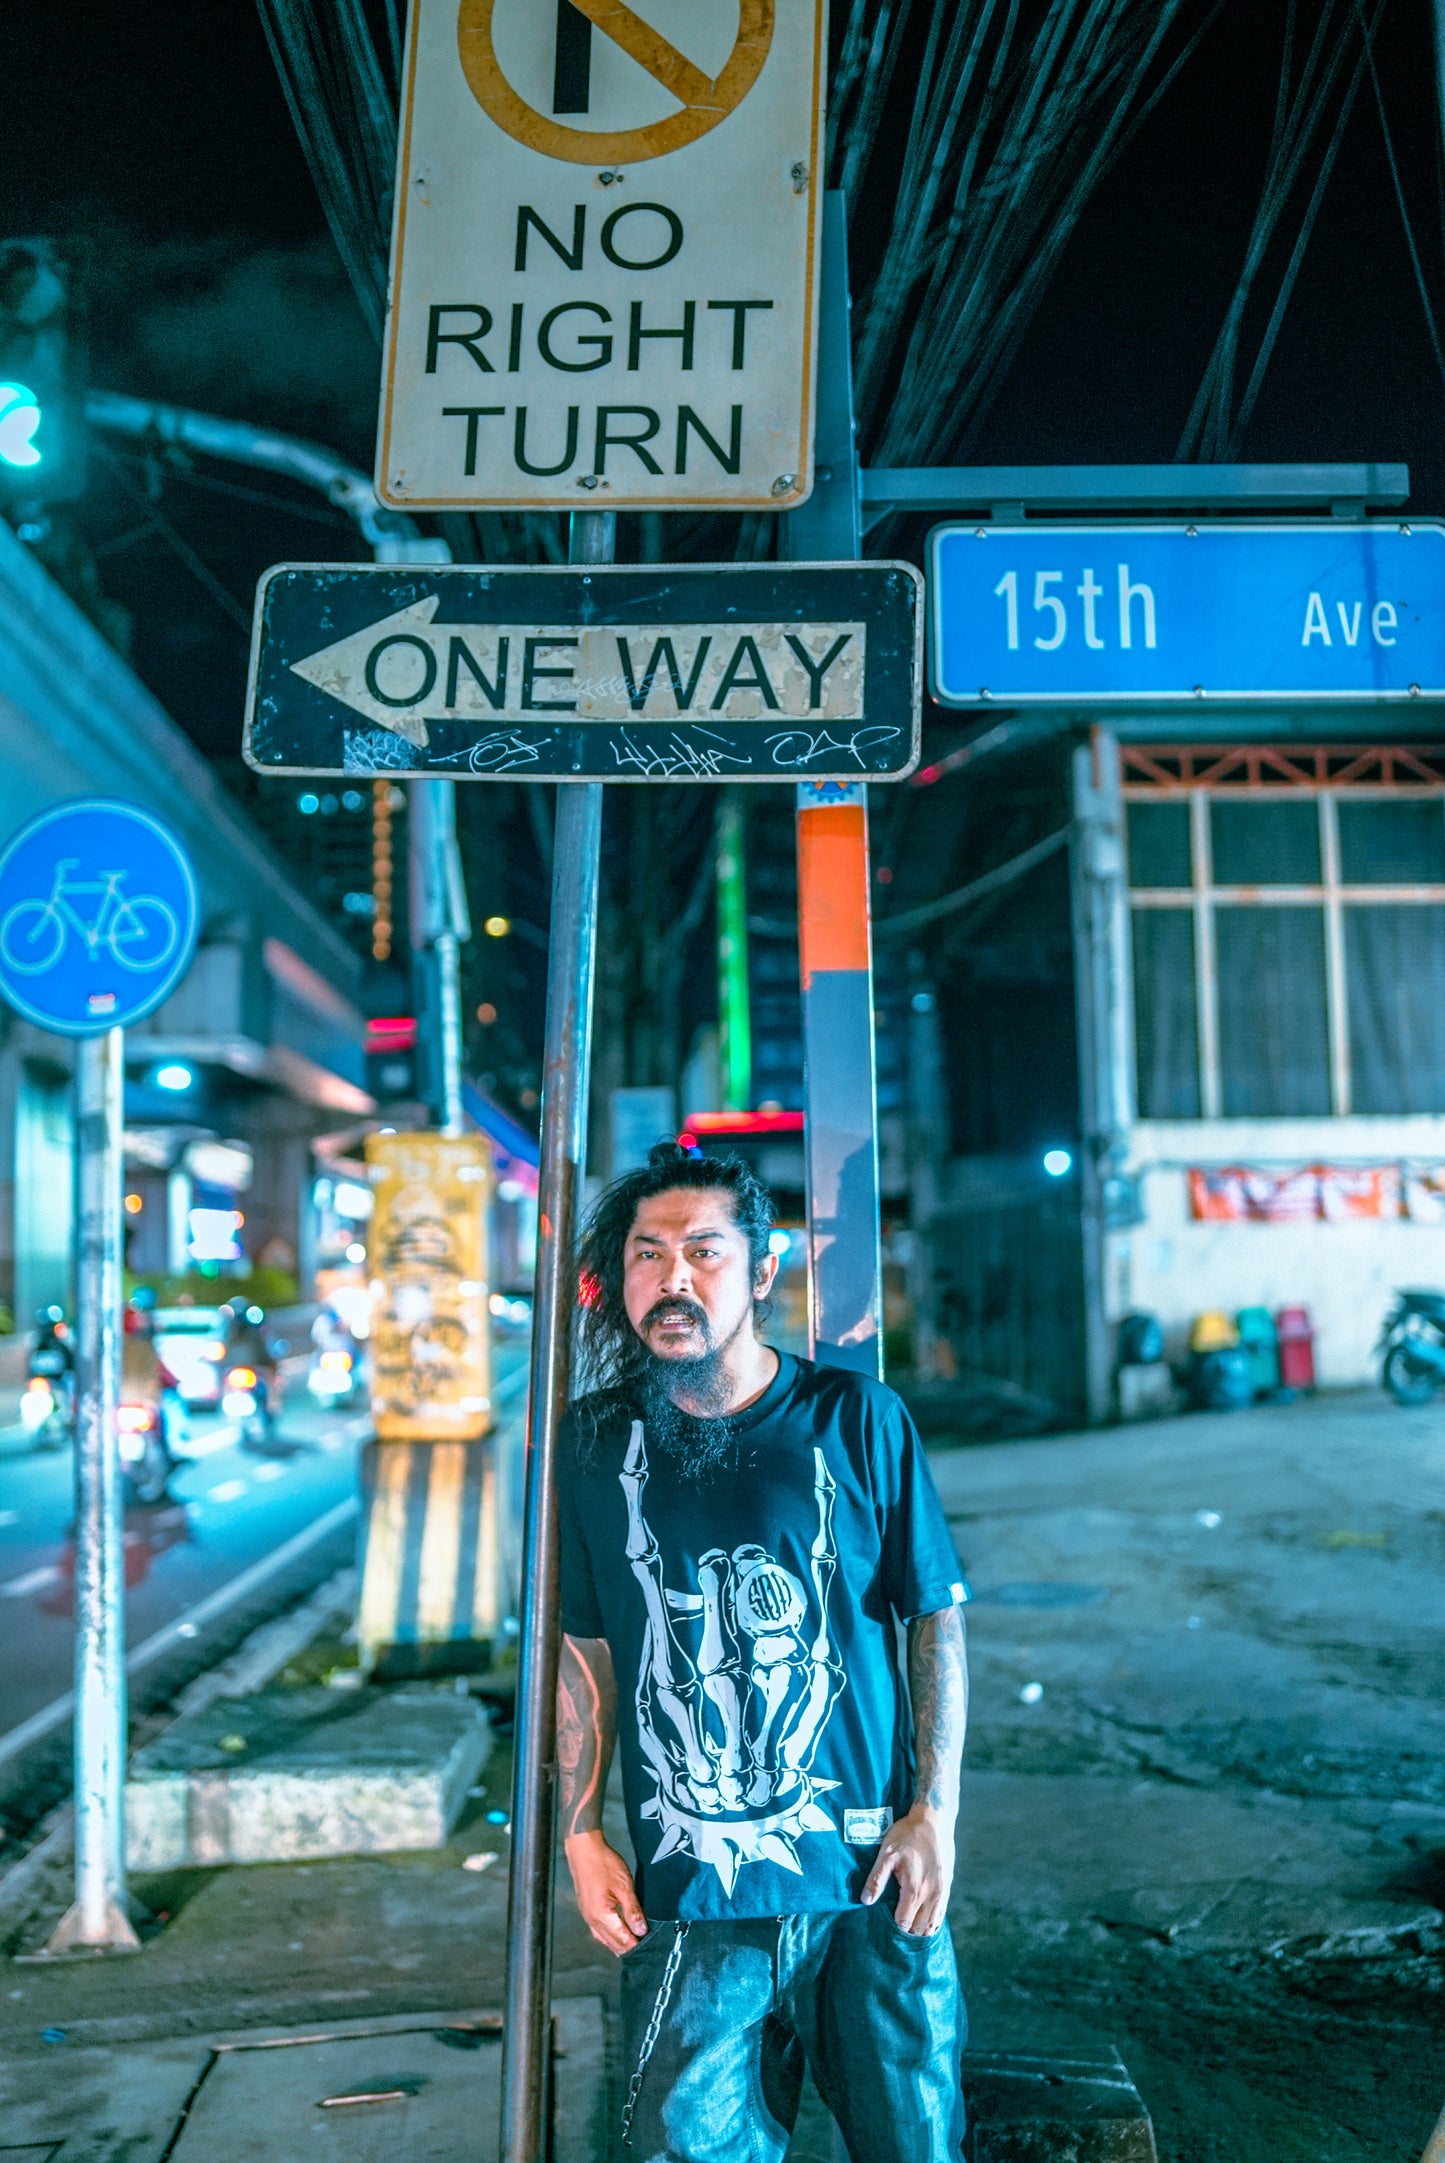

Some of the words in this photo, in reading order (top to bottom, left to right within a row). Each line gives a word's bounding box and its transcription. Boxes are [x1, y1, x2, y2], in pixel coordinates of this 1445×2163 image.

[514, 202, 684, 272] NO
[425, 300, 774, 373] RIGHT
[442, 405, 743, 476] TURN
[994, 563, 1156, 651] 15th
[1301, 592, 1398, 646] Ave
[365, 634, 578, 711] ONE
[616, 634, 853, 710] WAY
